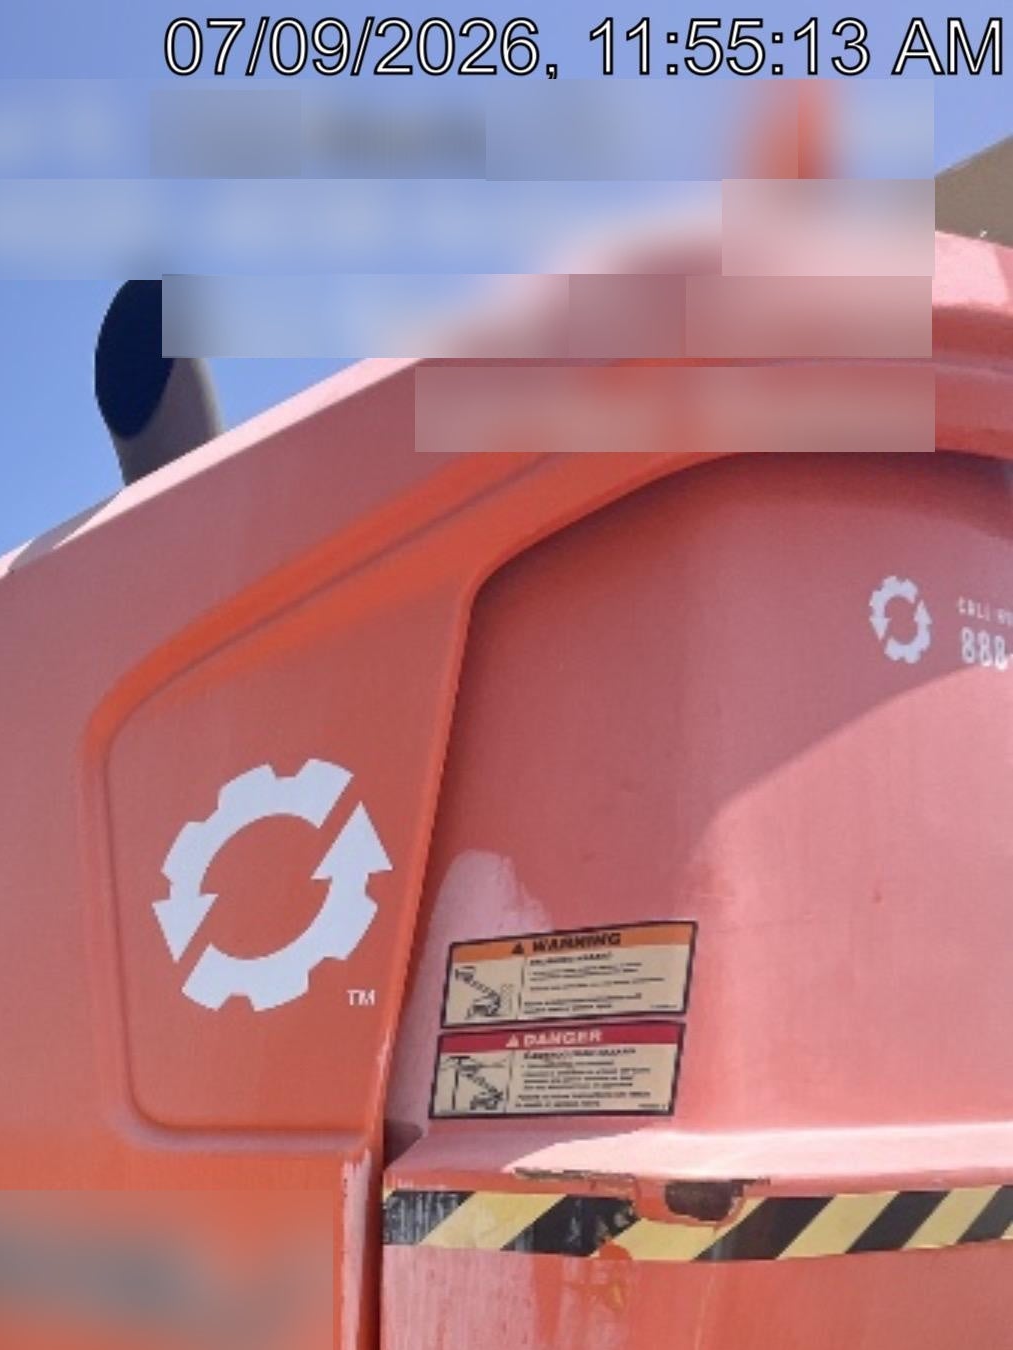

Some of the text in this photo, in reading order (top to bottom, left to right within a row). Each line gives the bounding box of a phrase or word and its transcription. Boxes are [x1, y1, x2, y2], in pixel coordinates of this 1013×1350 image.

[532, 932, 621, 953] WARNING
[346, 989, 376, 1006] TM
[523, 1030, 603, 1048] DANGER
